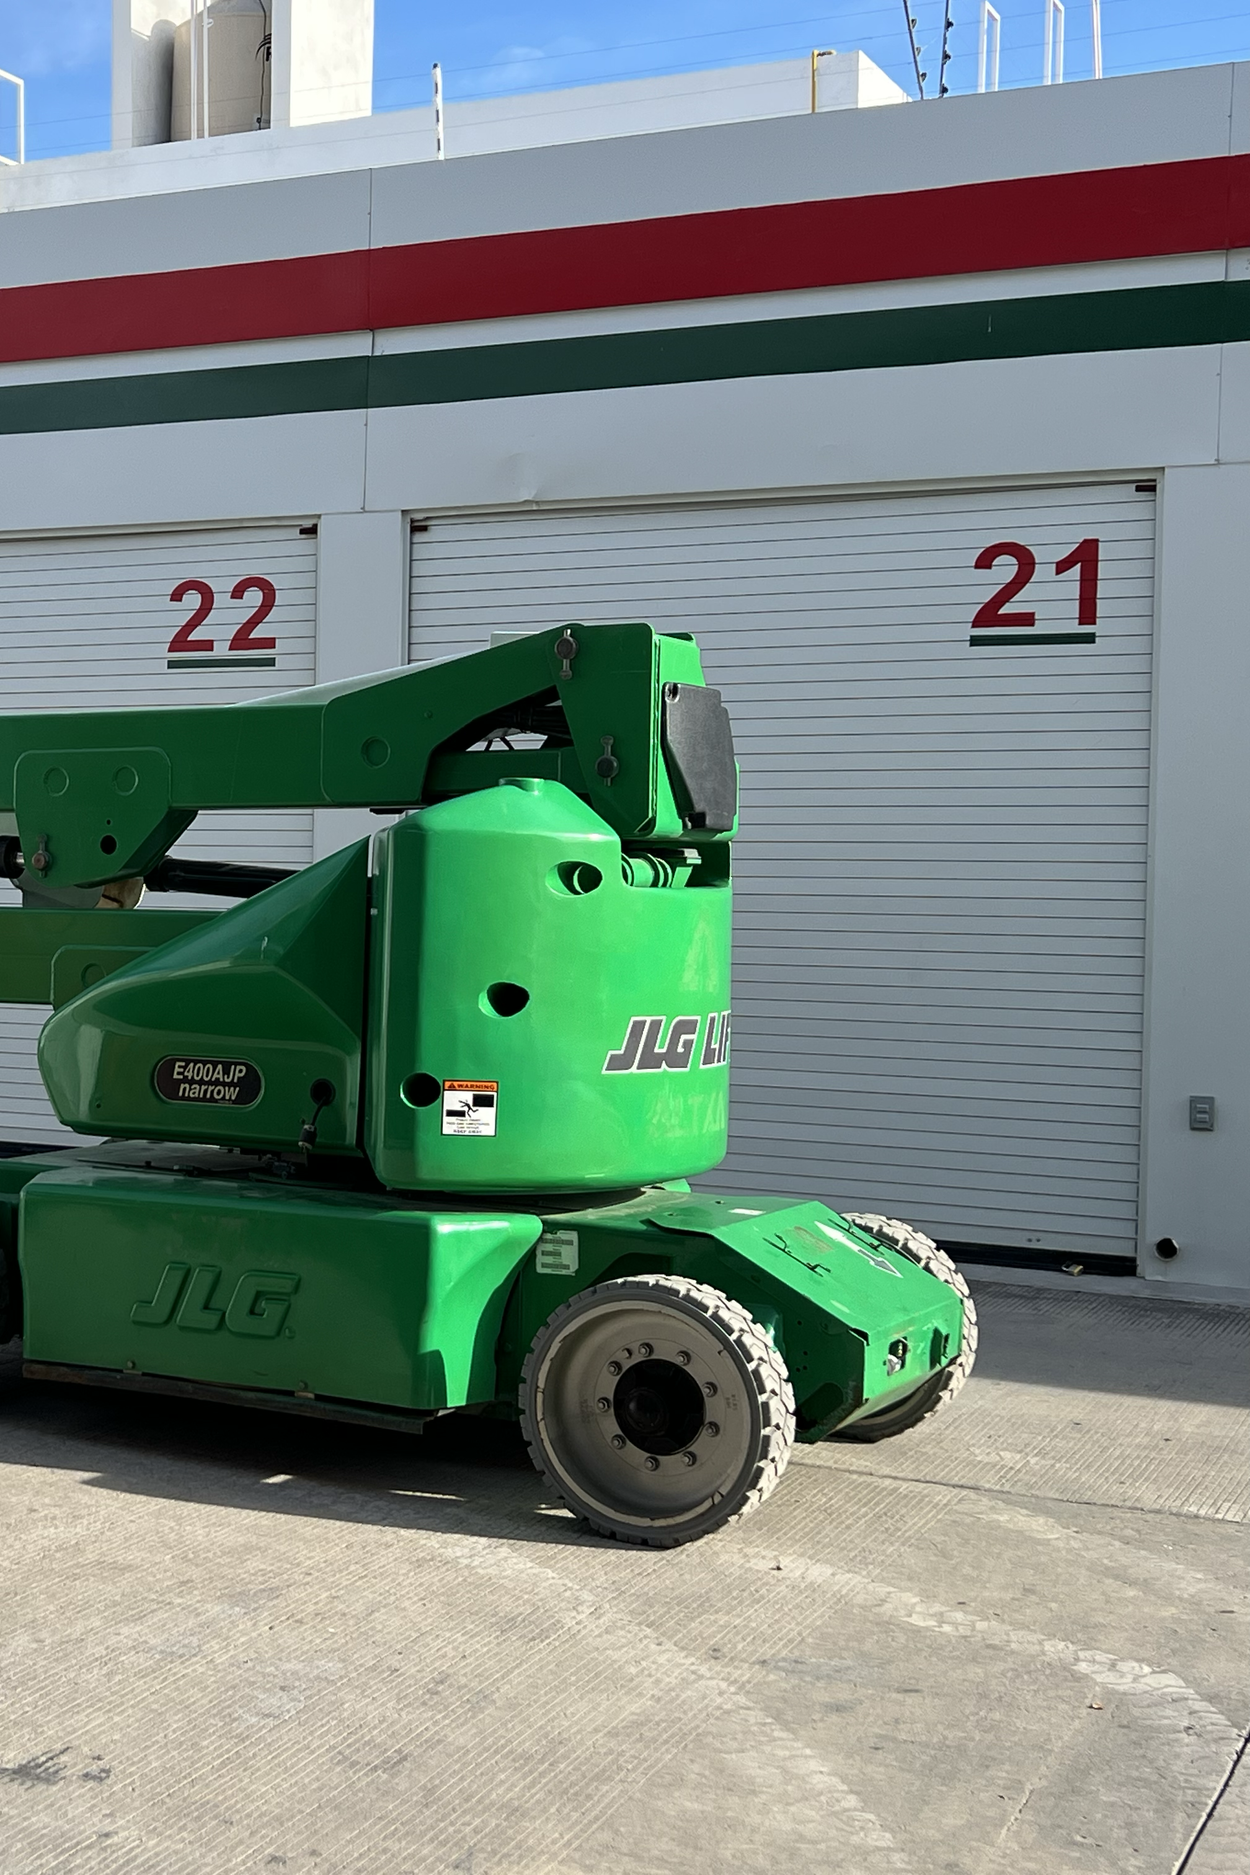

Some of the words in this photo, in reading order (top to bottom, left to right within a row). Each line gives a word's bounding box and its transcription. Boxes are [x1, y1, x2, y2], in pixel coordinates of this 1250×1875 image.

[167, 576, 277, 653] 22
[970, 538, 1100, 629] 21
[172, 1061, 247, 1083] E400AJP
[601, 1015, 701, 1074] JLG
[178, 1083, 240, 1101] narrow
[130, 1261, 302, 1340] JLG
